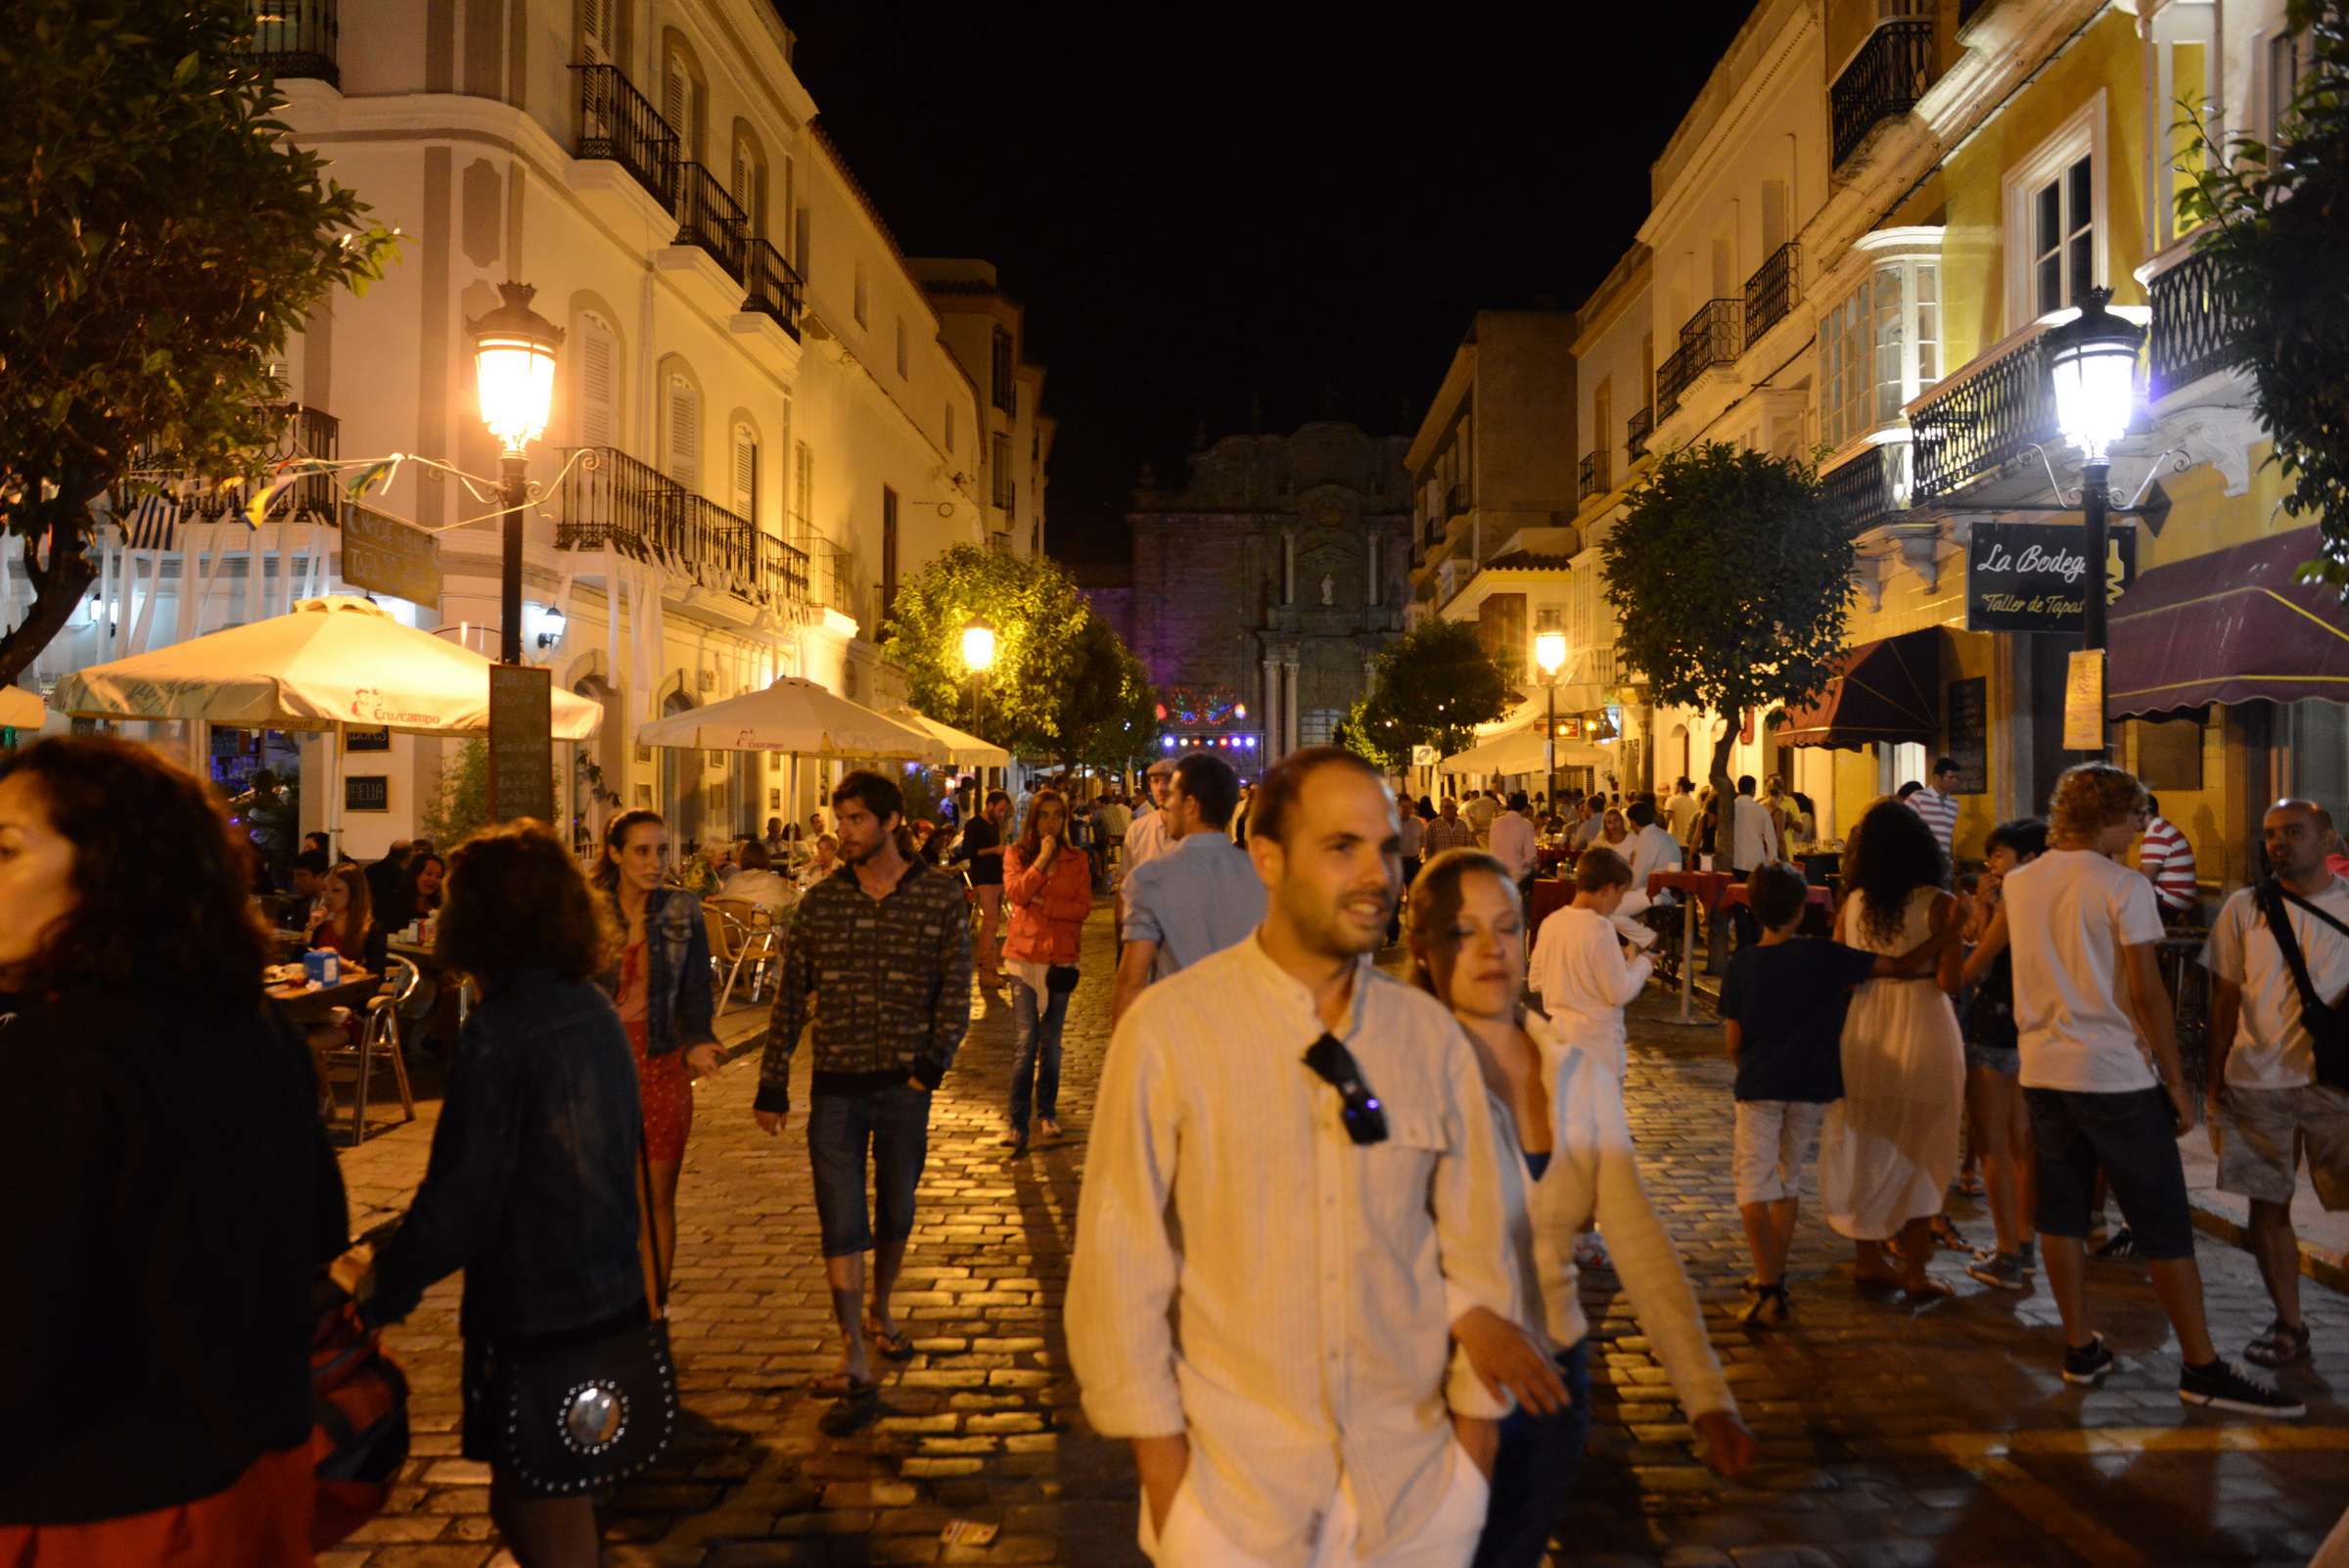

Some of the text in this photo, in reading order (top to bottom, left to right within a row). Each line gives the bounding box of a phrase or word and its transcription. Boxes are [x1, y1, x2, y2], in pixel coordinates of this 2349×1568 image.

[1977, 543, 2011, 572] La
[2027, 595, 2044, 613] de
[373, 709, 441, 725] Cruzcampo
[346, 782, 384, 802] PAELLA
